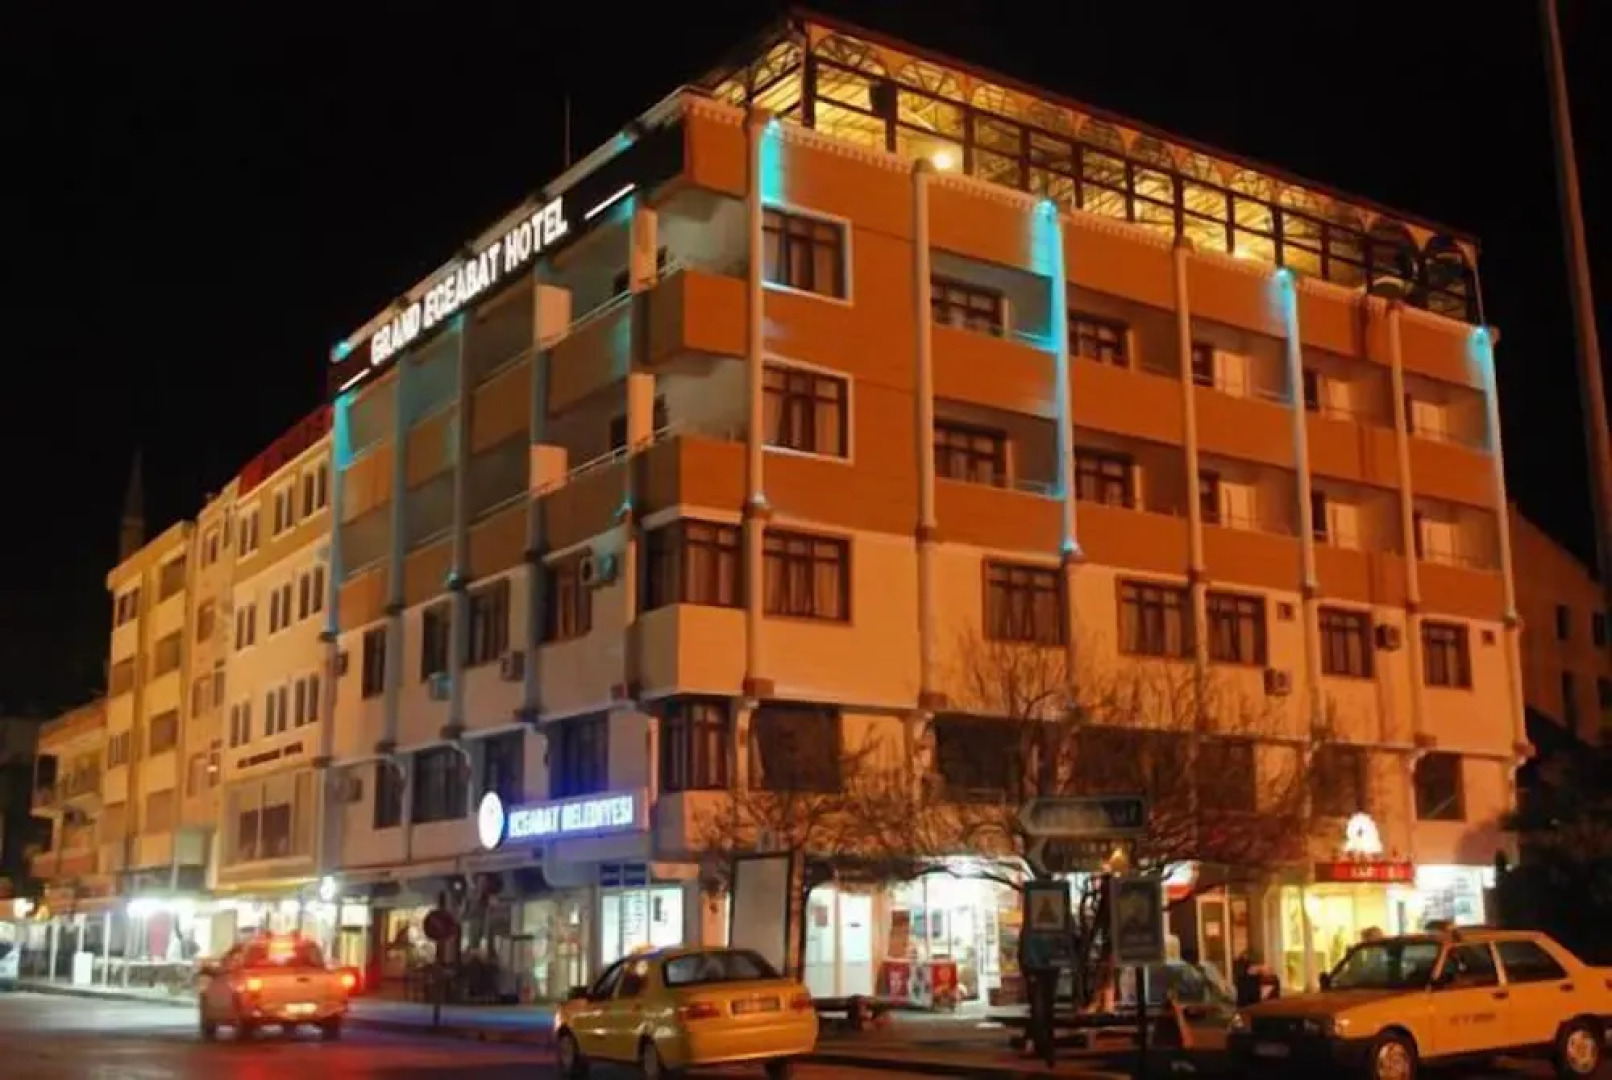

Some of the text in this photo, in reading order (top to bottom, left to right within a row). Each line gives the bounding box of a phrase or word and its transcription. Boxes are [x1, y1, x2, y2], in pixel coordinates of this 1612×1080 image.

[371, 196, 568, 365] GRAND ECEABAT HOTEL
